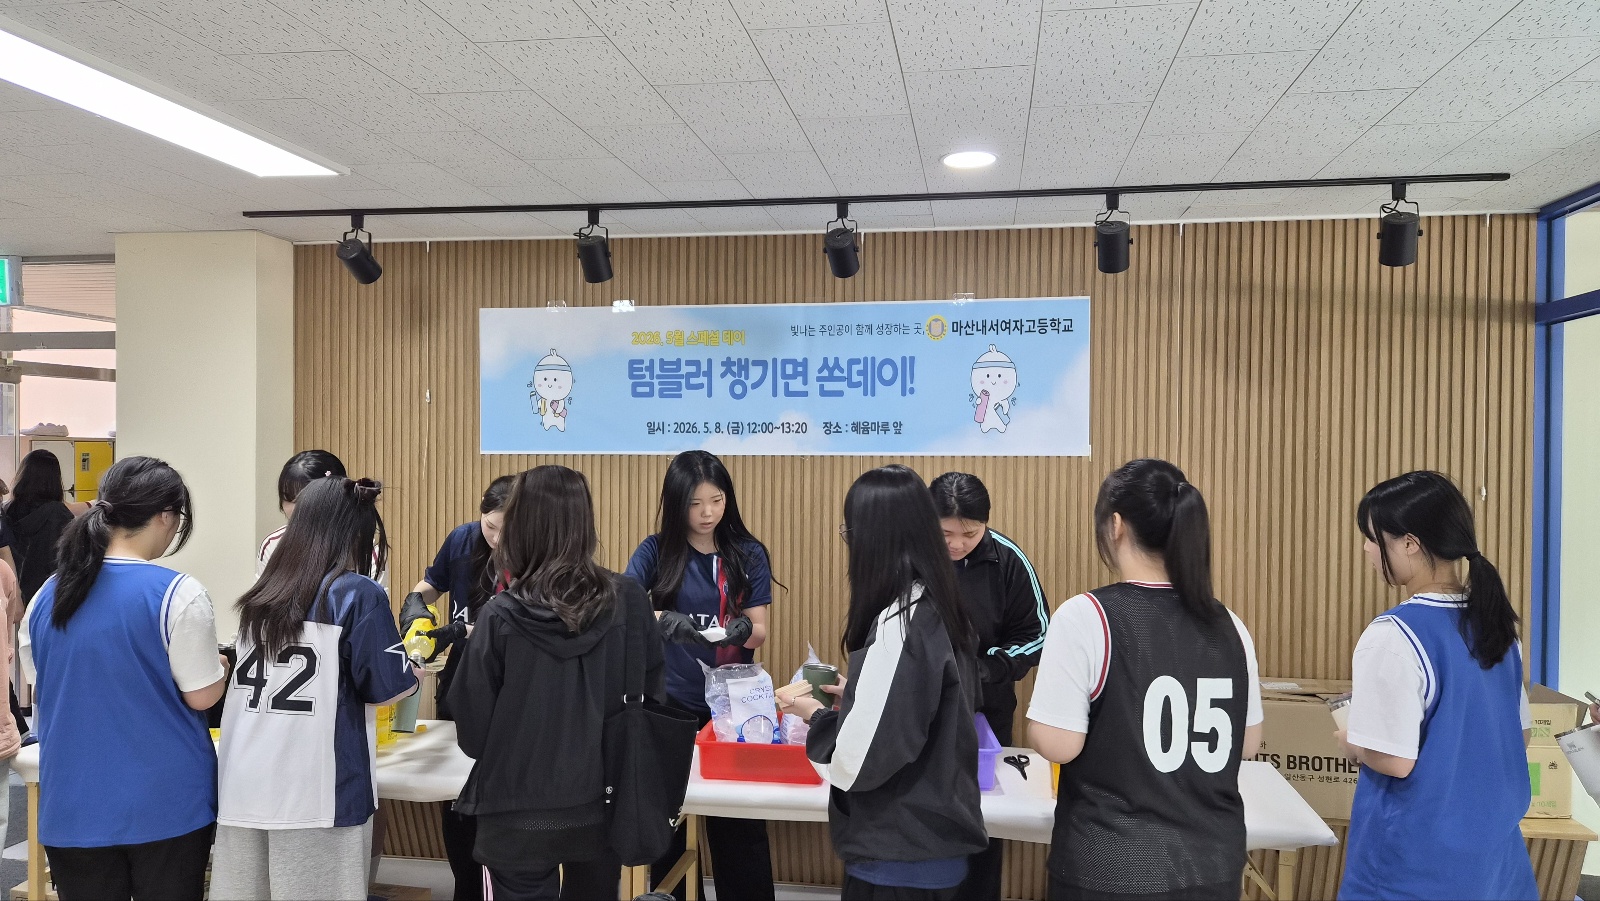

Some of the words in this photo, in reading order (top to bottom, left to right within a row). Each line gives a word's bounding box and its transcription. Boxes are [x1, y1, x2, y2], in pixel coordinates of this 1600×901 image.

[790, 324, 816, 337] 빛나는
[818, 323, 853, 337] 주인공이
[855, 323, 873, 336] 함께
[875, 322, 911, 336] 성장하는
[951, 317, 1074, 336] 마산내서여자고등학교
[666, 330, 685, 347] 5월
[686, 329, 720, 347] 스페셜
[722, 329, 746, 346] 데이
[627, 357, 713, 399] 텀블러
[719, 356, 809, 400] 챙기면
[815, 355, 916, 398] 쏜데이!
[646, 421, 665, 435] 일시
[673, 421, 701, 434] 2026.
[726, 421, 744, 435] (금)
[746, 421, 808, 434] 12:00~13:20
[822, 421, 843, 435] 장소
[850, 421, 891, 435] 혜윰마루
[892, 420, 903, 435] 앞
[233, 640, 322, 716] 42
[1142, 675, 1233, 773] 05
